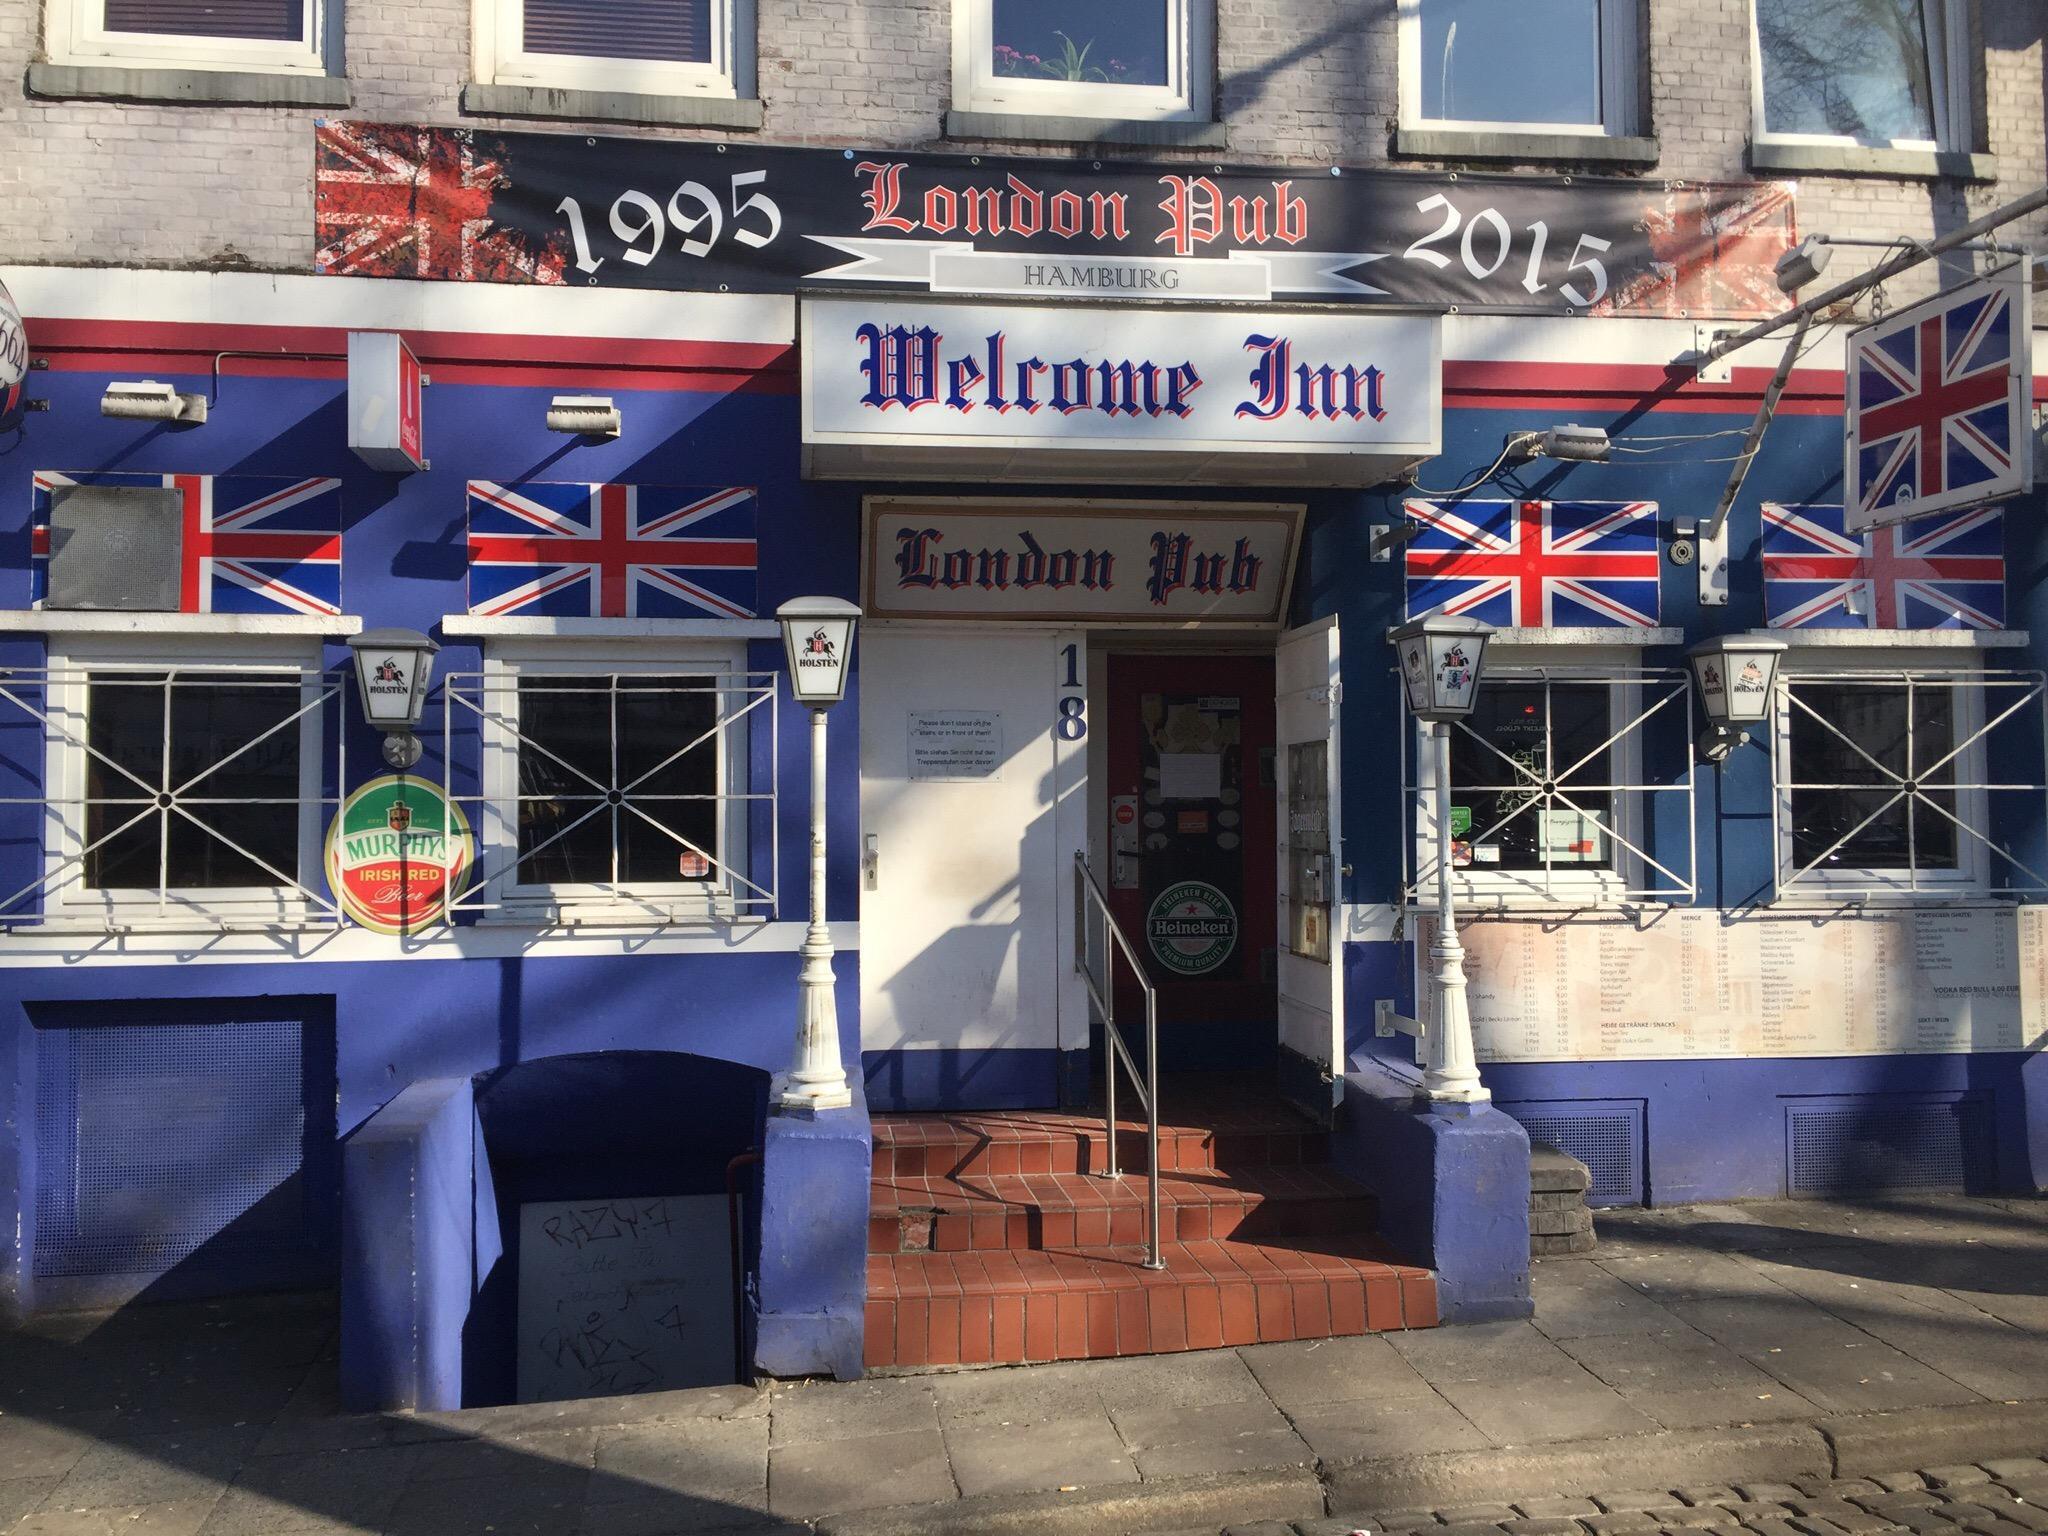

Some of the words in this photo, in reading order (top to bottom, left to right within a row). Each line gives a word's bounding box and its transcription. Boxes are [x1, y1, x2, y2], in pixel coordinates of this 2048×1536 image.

[854, 161, 1130, 241] London
[1155, 174, 1308, 256] Pub
[555, 170, 781, 274] 1995
[1403, 192, 1612, 306] 2015
[1024, 264, 1179, 289] HAMBURG
[855, 321, 1203, 420] Welcome
[1233, 332, 1385, 424] Inn
[895, 527, 1116, 591] London
[1146, 530, 1263, 606] Pub
[800, 658, 839, 668] HOLSTEN
[370, 686, 408, 694] HOLSTEN
[360, 870, 401, 882] IRISH
[408, 869, 439, 881] RED
[371, 884, 424, 904] Beer
[1162, 889, 1200, 909] HEINEKEN
[1203, 891, 1224, 908] BEER
[1155, 921, 1229, 935] Heineken
[1195, 945, 1224, 966] QUALITY
